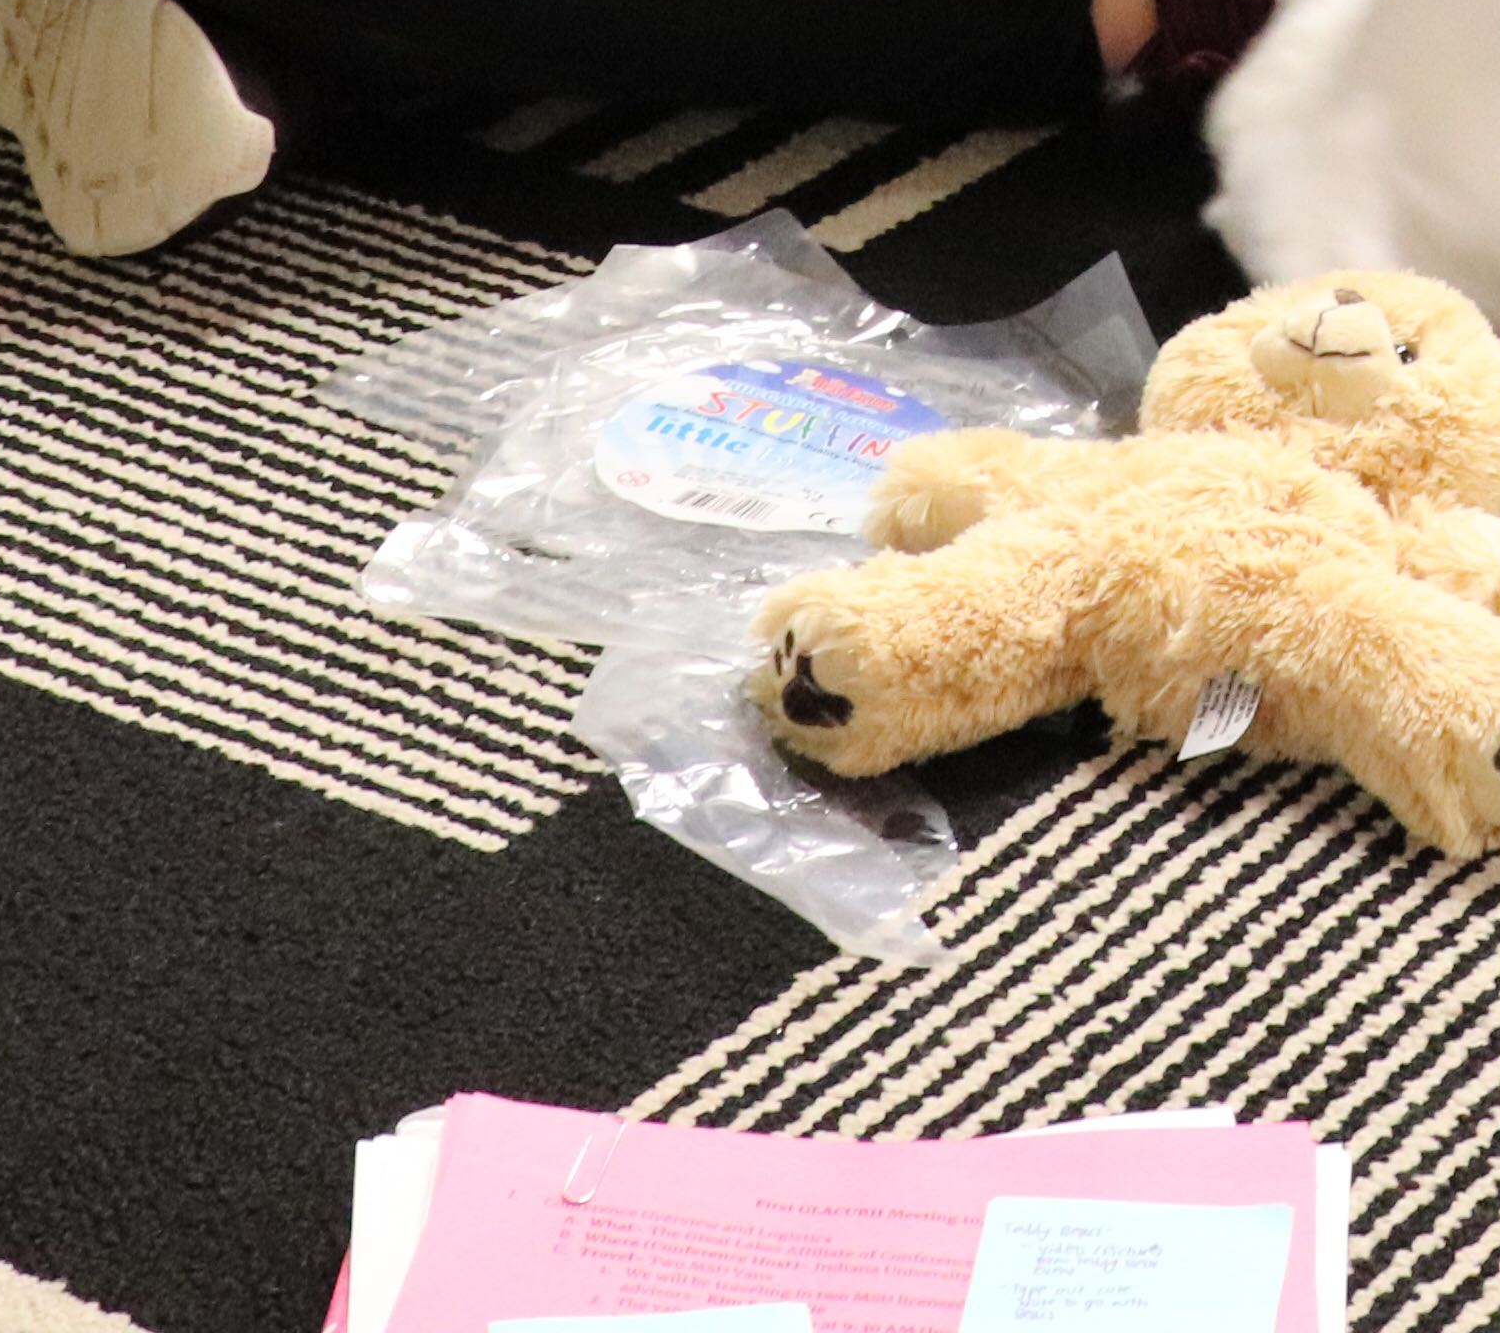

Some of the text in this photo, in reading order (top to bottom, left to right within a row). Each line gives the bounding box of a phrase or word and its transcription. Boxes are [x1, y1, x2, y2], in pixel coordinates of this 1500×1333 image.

[645, 414, 750, 454] little
[696, 389, 893, 458] STUFFIN
[641, 1211, 719, 1229] Overview
[723, 1223, 756, 1235] and
[758, 1227, 832, 1244] Logistics
[755, 1198, 794, 1212] First
[887, 1208, 958, 1226] Meeting
[585, 1231, 640, 1246] Where
[813, 1261, 880, 1274] Indiana
[883, 1265, 972, 1282] University
[786, 1246, 854, 1259] Affiliate
[655, 1273, 688, 1284] will
[714, 1280, 791, 1300] traveling
